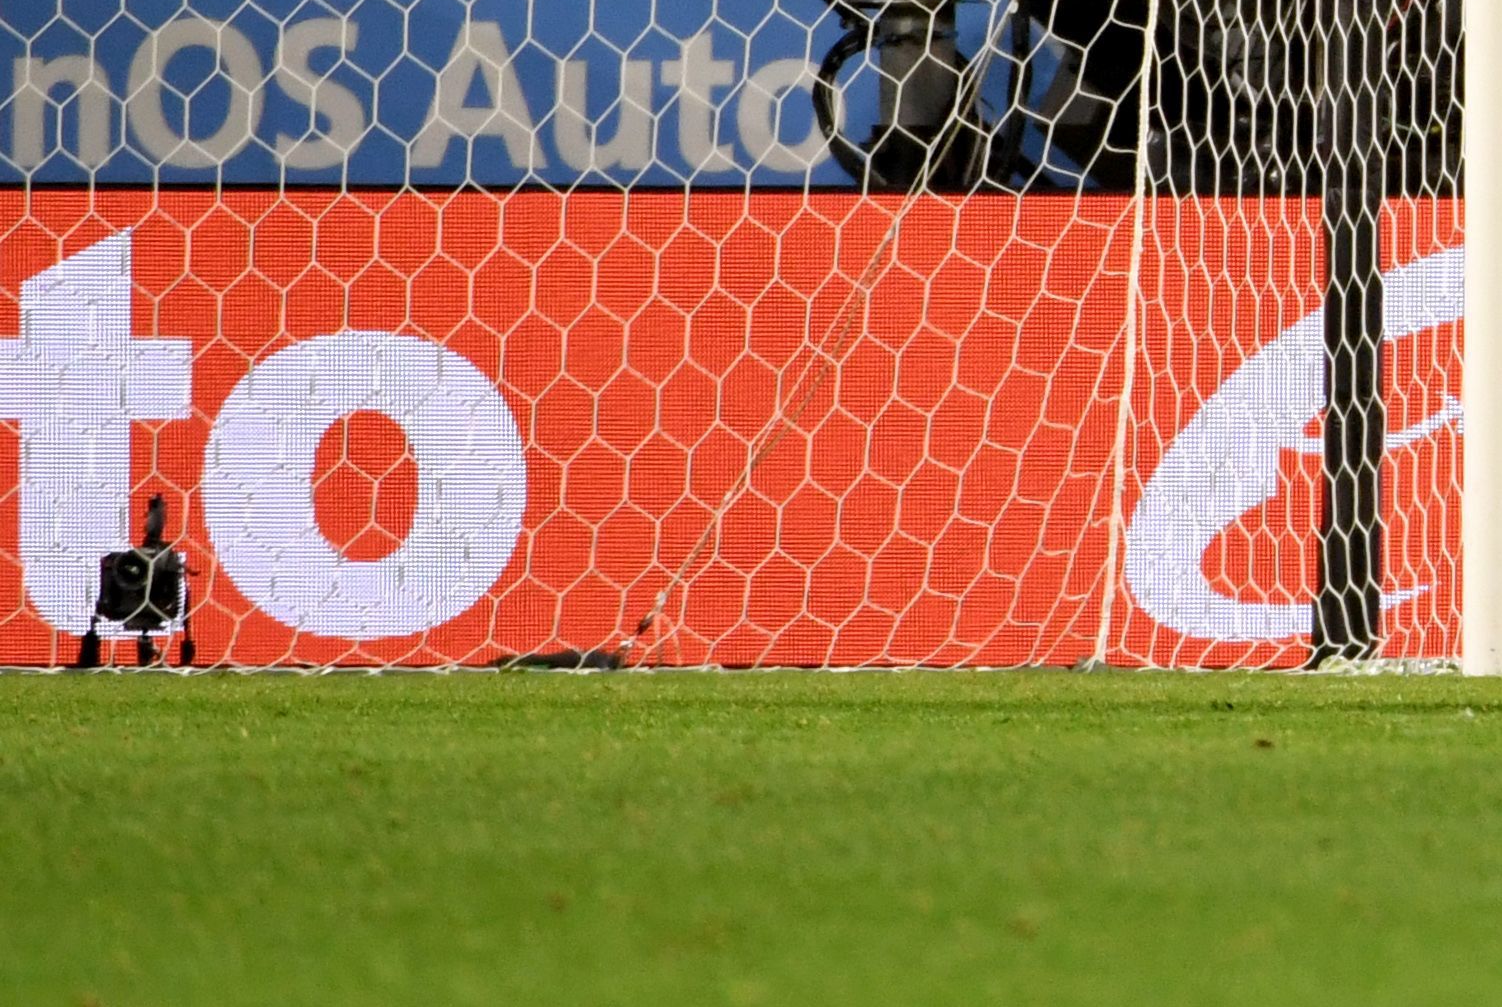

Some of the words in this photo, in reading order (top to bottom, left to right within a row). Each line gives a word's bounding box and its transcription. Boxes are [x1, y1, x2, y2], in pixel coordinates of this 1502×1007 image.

[11, 17, 366, 172] nOS
[408, 19, 847, 174] Auto
[0, 226, 528, 641] to
